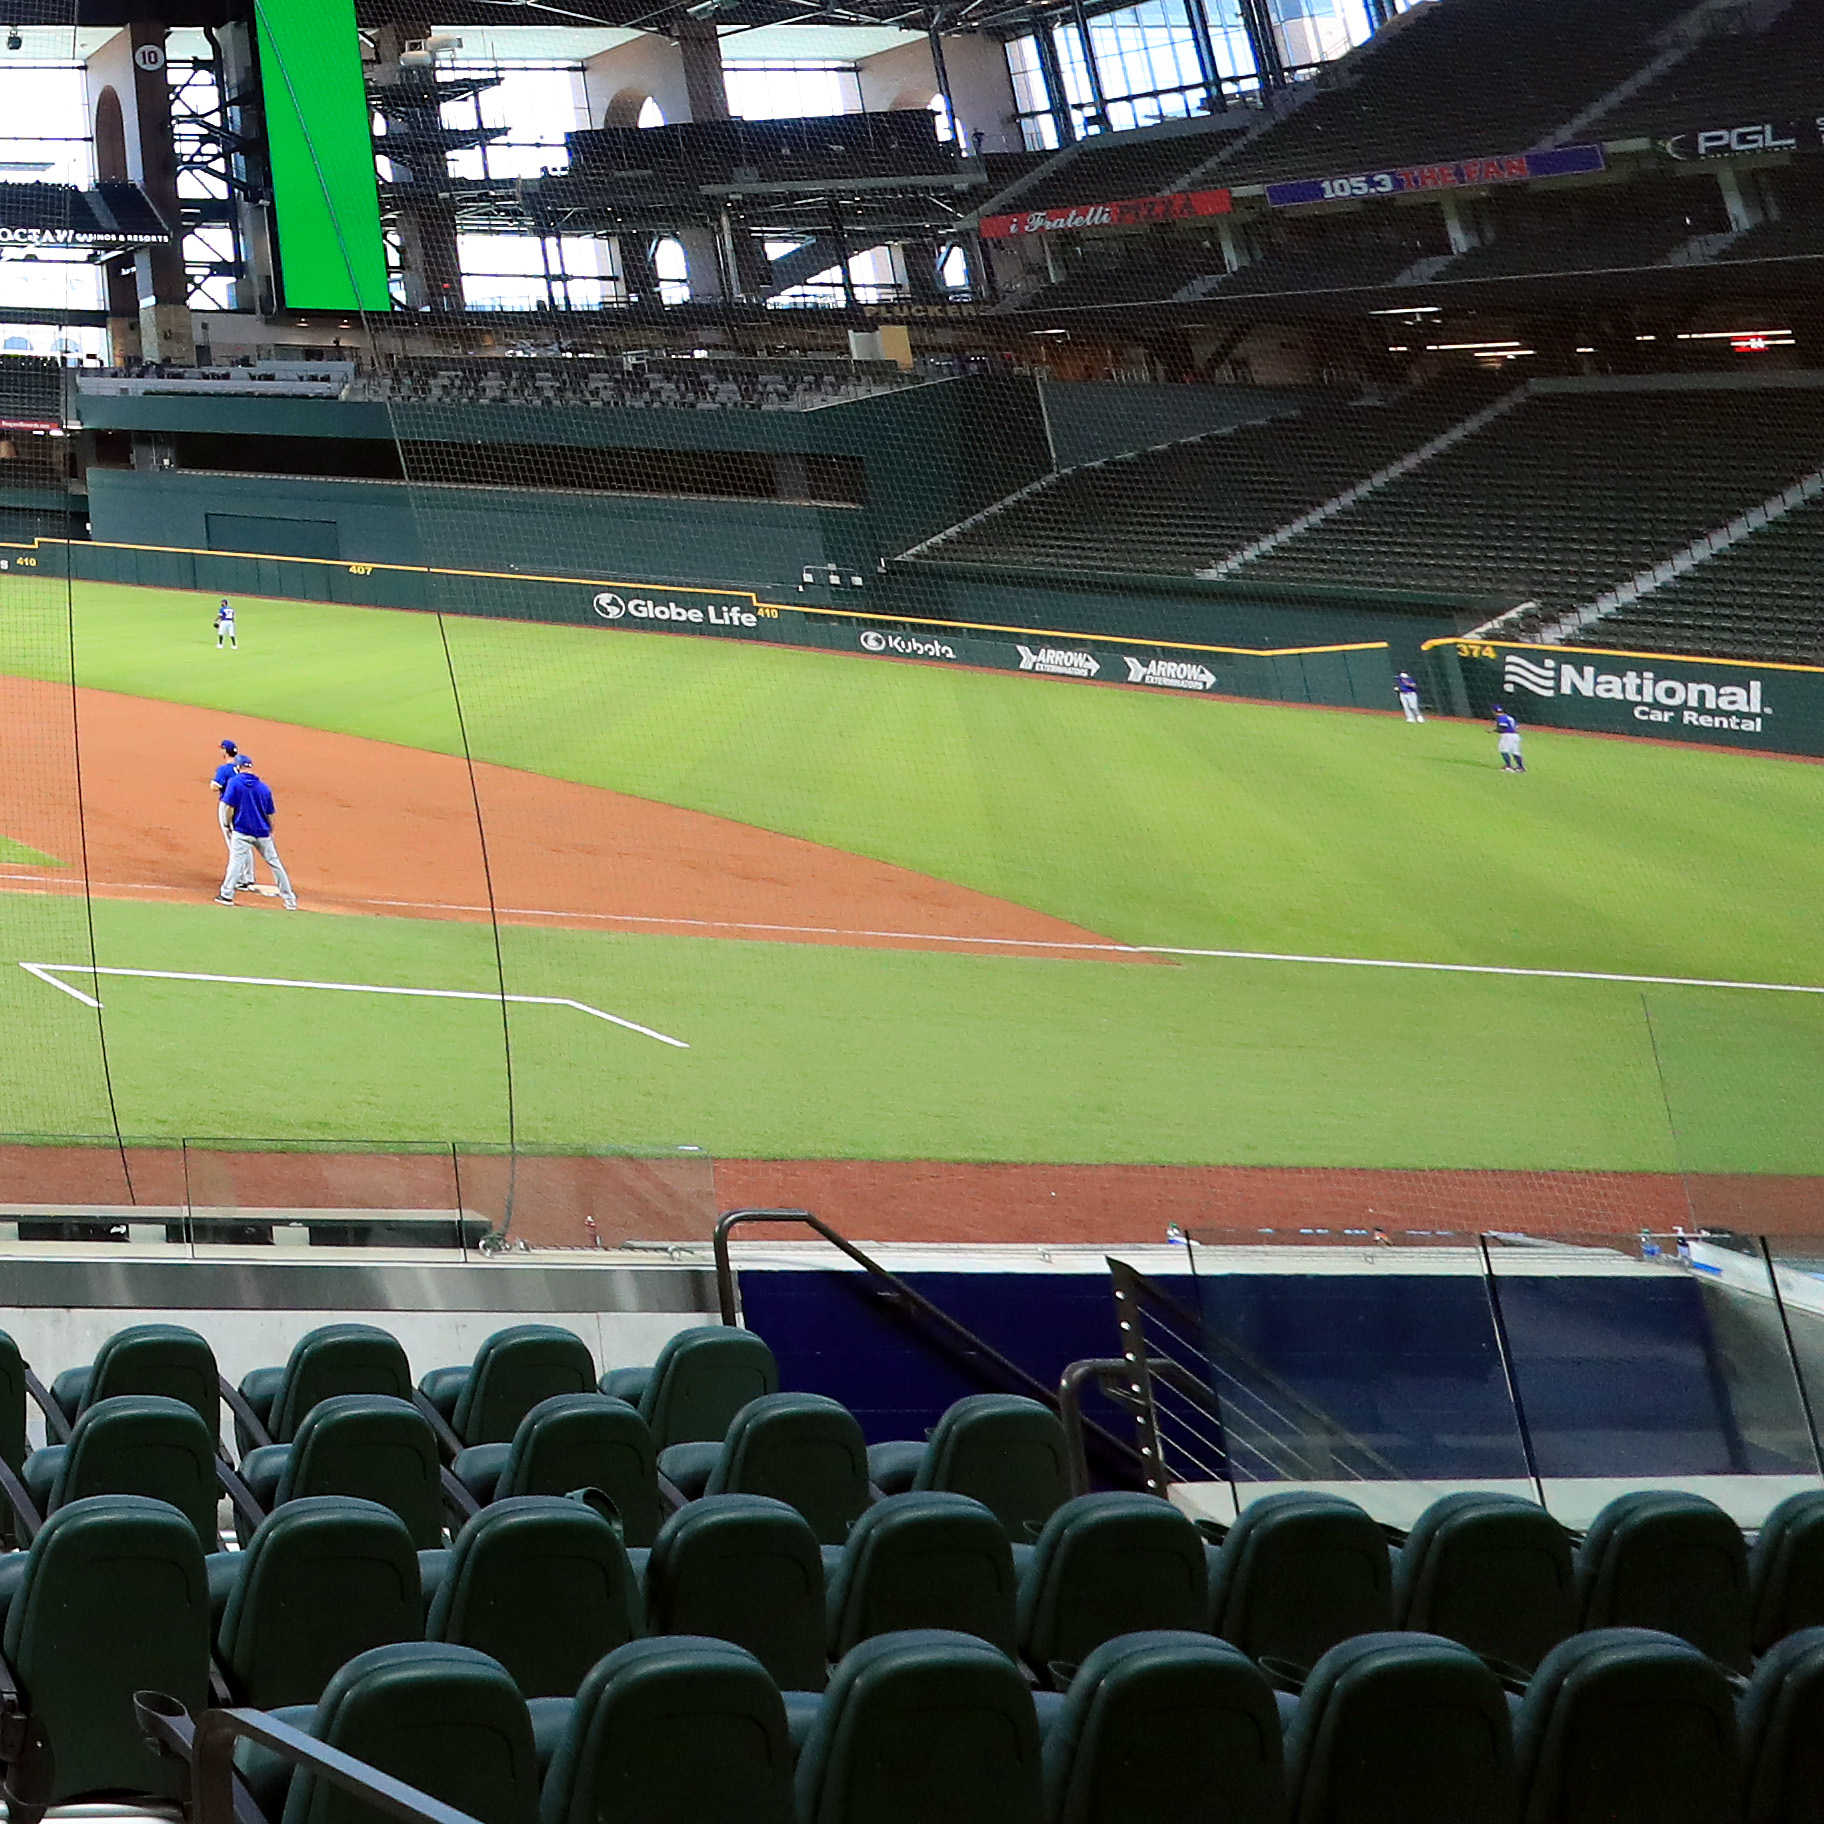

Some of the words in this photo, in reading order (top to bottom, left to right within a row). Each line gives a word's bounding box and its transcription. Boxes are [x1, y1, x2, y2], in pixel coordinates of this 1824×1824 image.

[141, 50, 158, 64] 10
[1697, 123, 1796, 155] PGL
[1321, 172, 1394, 199] 105.3
[1399, 166, 1458, 189] THE
[1463, 157, 1529, 184] FAN
[1009, 218, 1019, 234] i
[1025, 206, 1112, 233] Fratelli
[127, 234, 169, 243] RESORTS
[16, 556, 37, 567] 410
[349, 565, 373, 576] 407
[627, 598, 704, 624] Globe
[708, 605, 757, 628] Life
[757, 607, 779, 619] 410
[887, 634, 957, 659] Kubota
[1457, 644, 1497, 659] 374
[1036, 648, 1088, 668] ARROW
[1035, 662, 1089, 677] EXTERMINATORS
[1147, 660, 1202, 680] ARROW
[1144, 674, 1204, 690] EXTERMINATORS
[1559, 664, 1764, 714] National
[1633, 706, 1674, 724] Car
[1682, 710, 1763, 733] Rental
